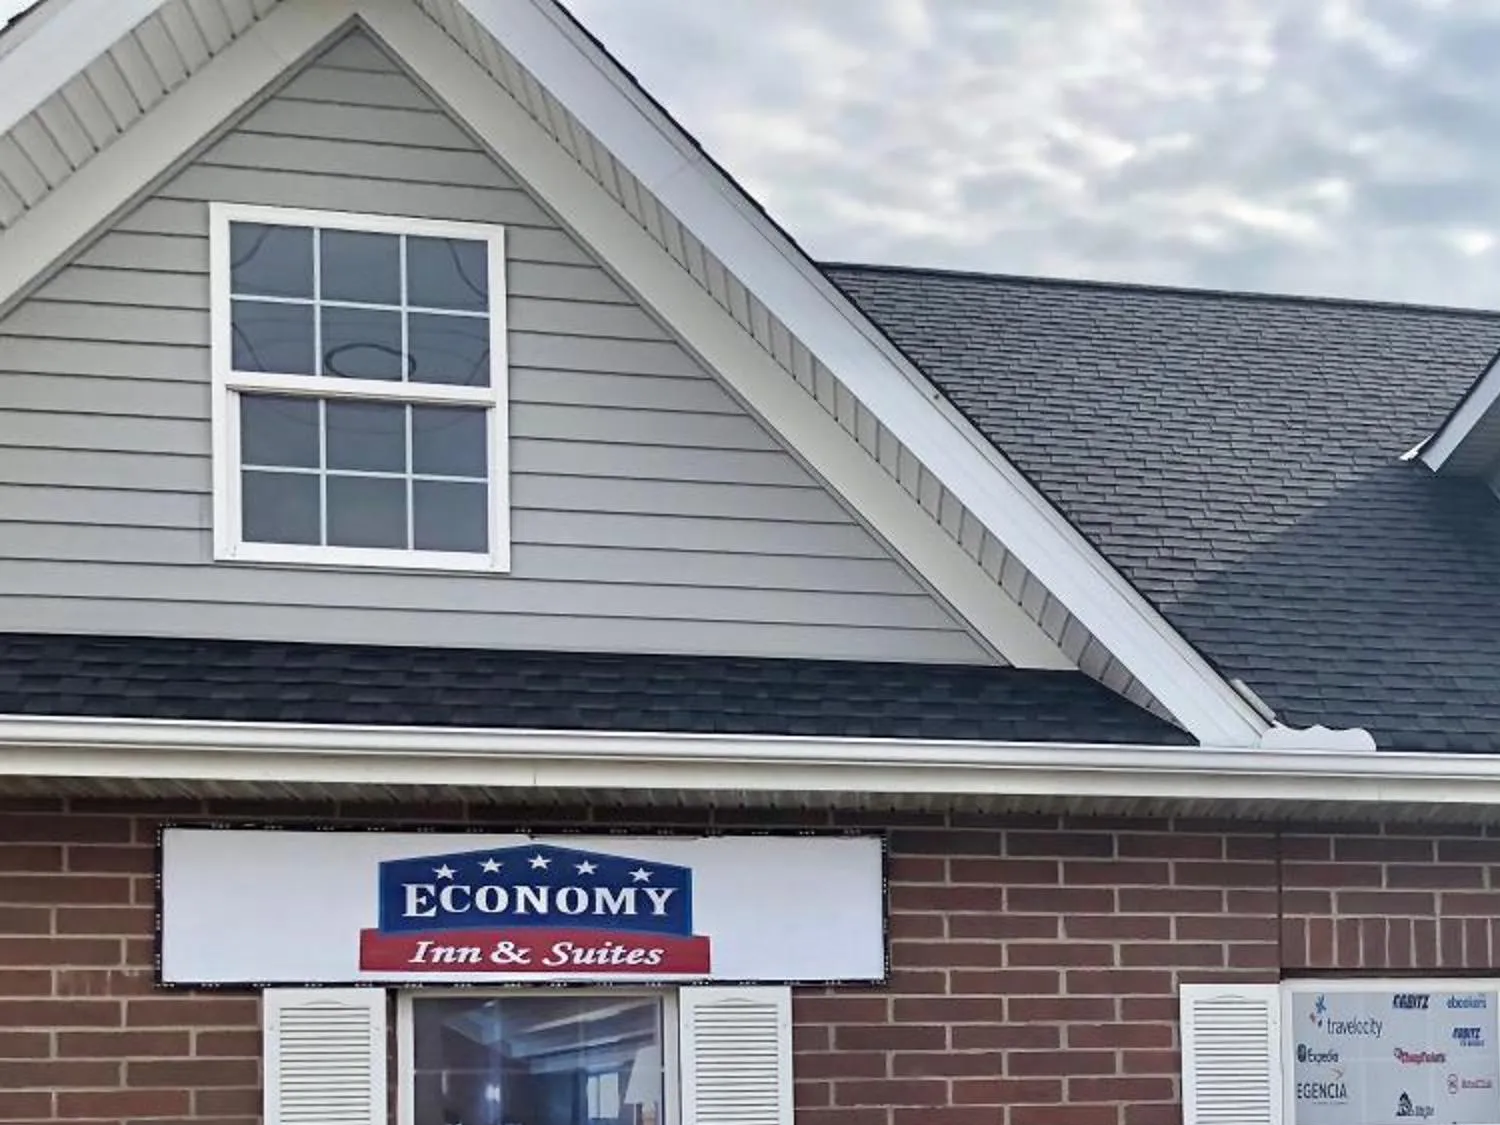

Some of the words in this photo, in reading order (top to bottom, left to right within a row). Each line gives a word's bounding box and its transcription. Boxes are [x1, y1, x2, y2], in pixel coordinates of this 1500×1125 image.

[402, 882, 678, 917] ECONOMY
[408, 940, 482, 964] Inn
[490, 940, 531, 965] &
[541, 941, 664, 966] Suites
[1327, 1015, 1383, 1039] travelocity
[1297, 1082, 1348, 1099] EGENCIA
